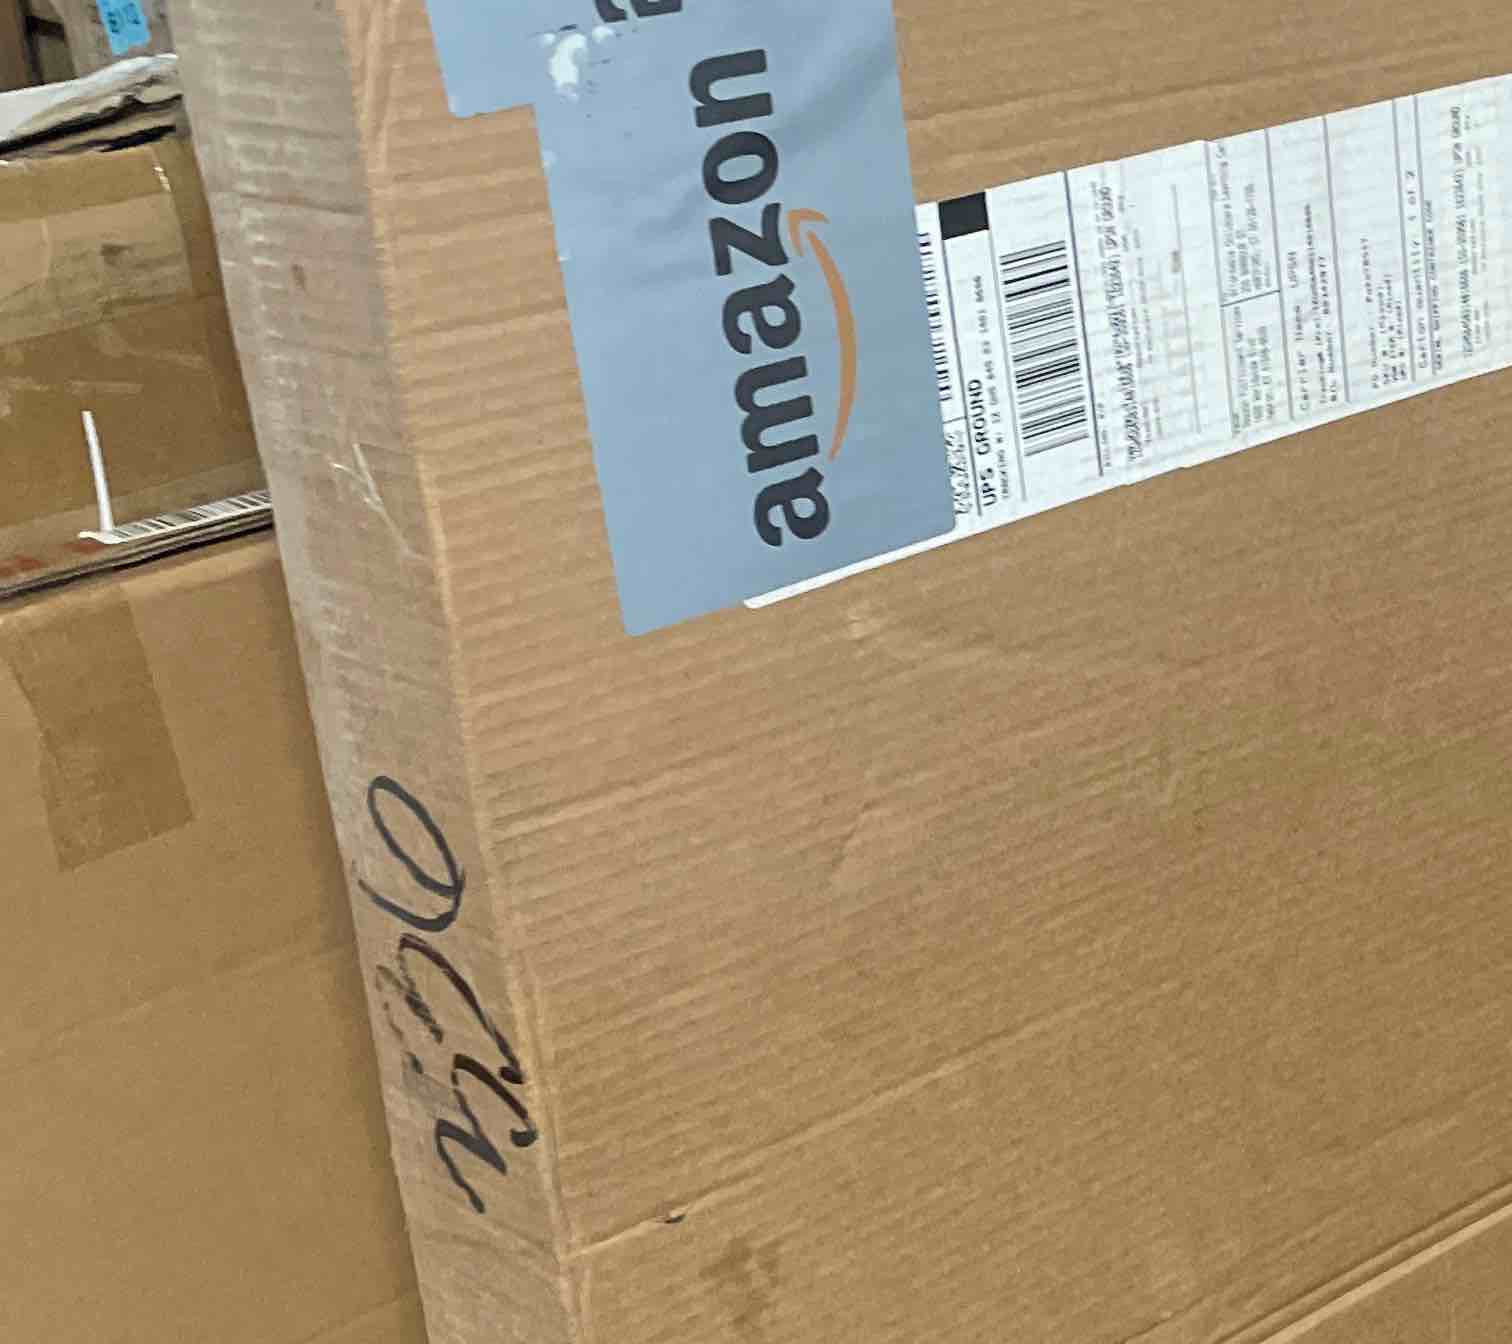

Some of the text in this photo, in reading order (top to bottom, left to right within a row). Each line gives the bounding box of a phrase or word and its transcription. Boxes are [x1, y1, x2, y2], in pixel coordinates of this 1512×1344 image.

[694, 49, 831, 548] amazon
[968, 379, 998, 507] UPS GROUND
